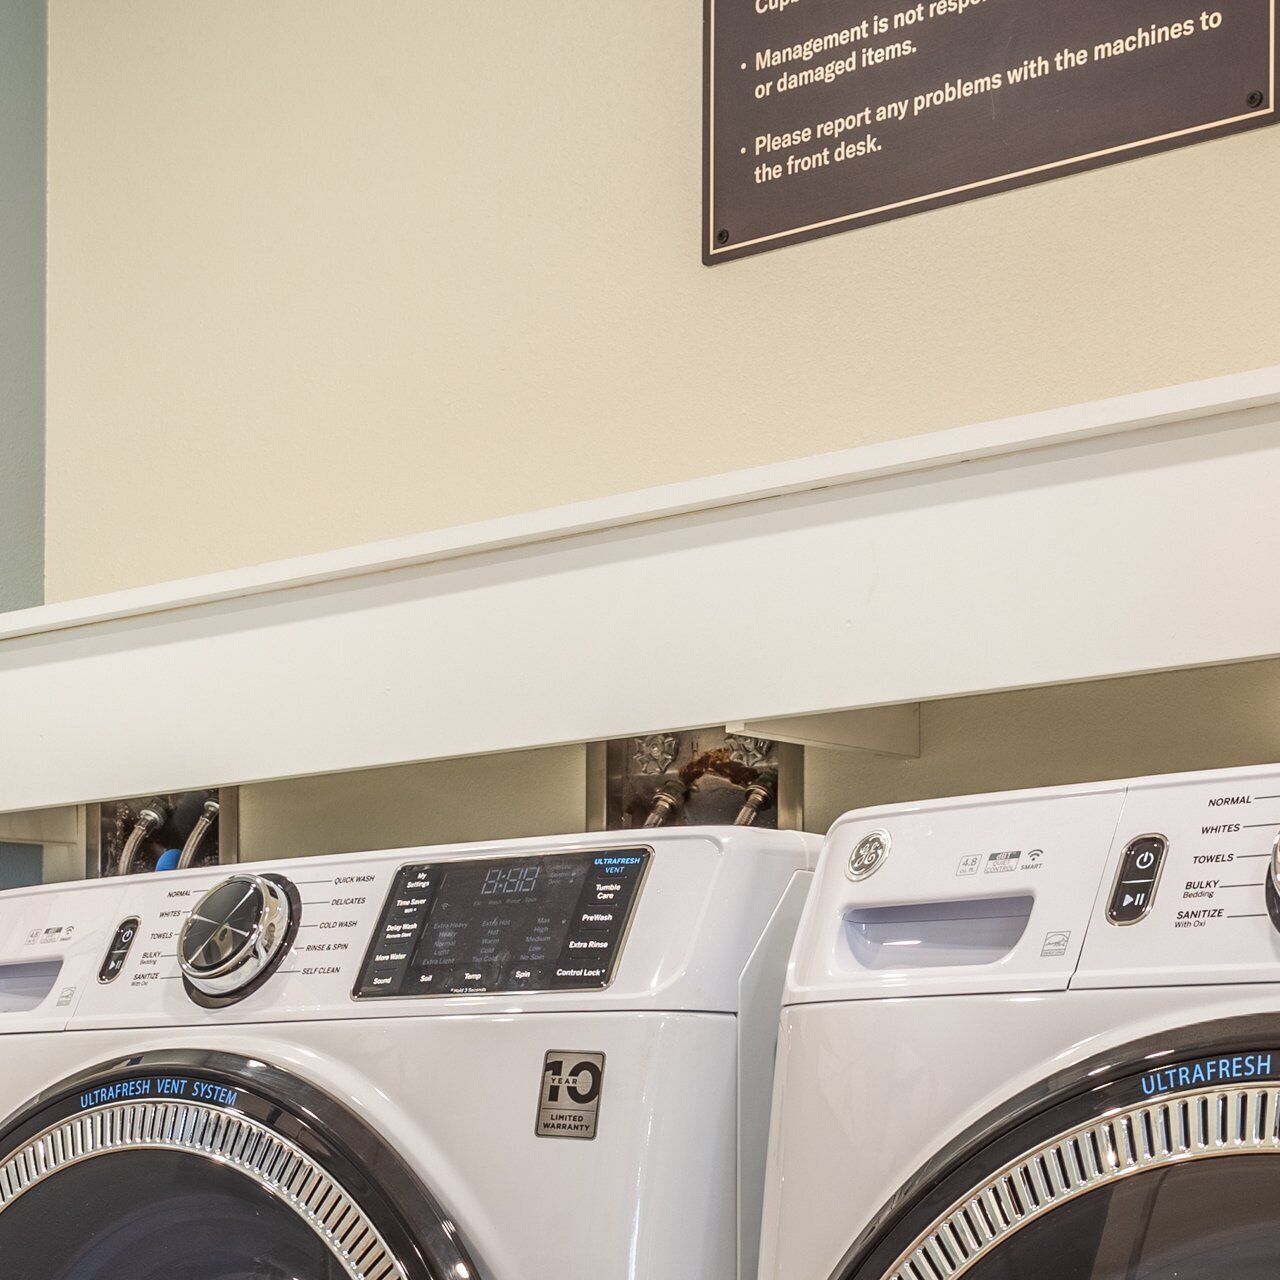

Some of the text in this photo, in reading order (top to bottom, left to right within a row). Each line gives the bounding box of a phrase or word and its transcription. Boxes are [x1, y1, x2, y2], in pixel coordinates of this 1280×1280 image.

[755, 0, 986, 71] Management is not resp
[754, 39, 917, 99] or damaged items.
[755, 11, 1223, 156] Please report any problems with the machines to
[754, 134, 882, 184] the front desk.
[1208, 795, 1252, 807] NORMAL
[1201, 823, 1241, 835] WHITES
[594, 857, 640, 865] ULTRAFRESH
[1192, 853, 1234, 864] TOWELS
[605, 866, 625, 874] VENT
[1020, 863, 1043, 871] SMART
[334, 877, 356, 885] QUICK
[1185, 879, 1220, 890] BULKY
[167, 890, 191, 898] NORMAL
[597, 892, 614, 900] Care
[1182, 890, 1214, 899] Bedding
[331, 897, 366, 906] DELICATES
[159, 910, 181, 918] WHITES
[1176, 908, 1224, 920] SANITIZE
[338, 920, 357, 928] WASH
[1174, 920, 1206, 928] With Oxi
[150, 932, 173, 940] TOWELS
[142, 951, 161, 959] BULKY
[133, 972, 159, 980] SANITIZE
[464, 973, 482, 981] Temp
[515, 970, 531, 979] Spin
[373, 977, 392, 985] Sound
[420, 975, 433, 983] Soil
[1141, 1054, 1271, 1095] ULTRAFRESH
[545, 1060, 601, 1104] 10
[551, 1077, 577, 1085] YEAR
[80, 1079, 238, 1108] ULTRAFRESH VENT SYSTEM
[550, 1114, 583, 1122] LIMITED
[543, 1122, 590, 1131] WARRANTY
